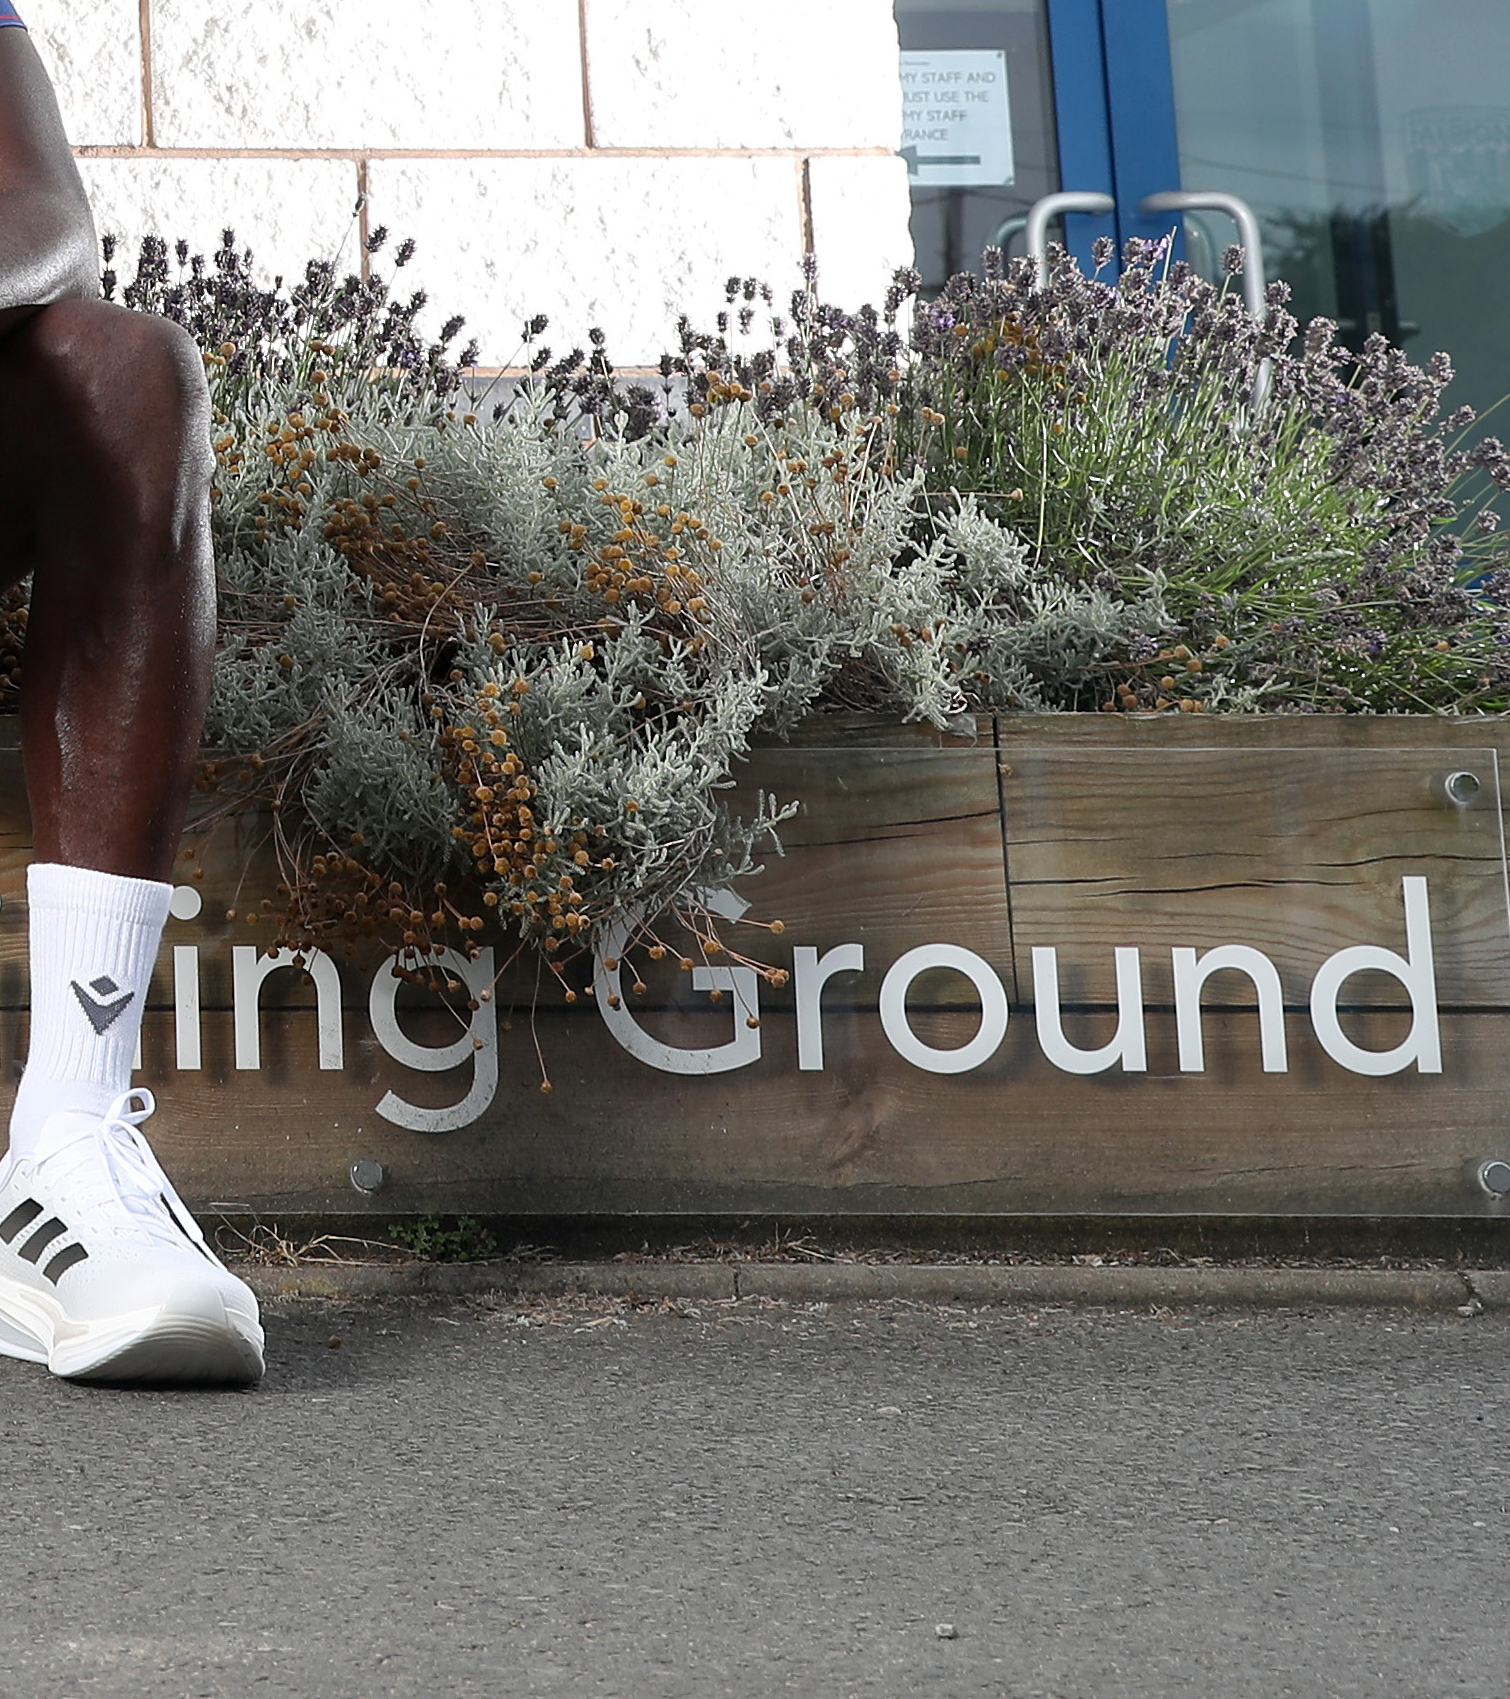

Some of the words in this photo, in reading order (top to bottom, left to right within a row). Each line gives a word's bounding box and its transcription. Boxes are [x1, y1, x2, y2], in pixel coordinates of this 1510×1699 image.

[922, 71, 961, 84] STAFF
[967, 71, 996, 84] AND
[903, 90, 930, 103] UST
[934, 90, 959, 103] USE
[964, 90, 989, 103] THE
[927, 109, 967, 122] STAFF
[592, 875, 1444, 1076] Ground
